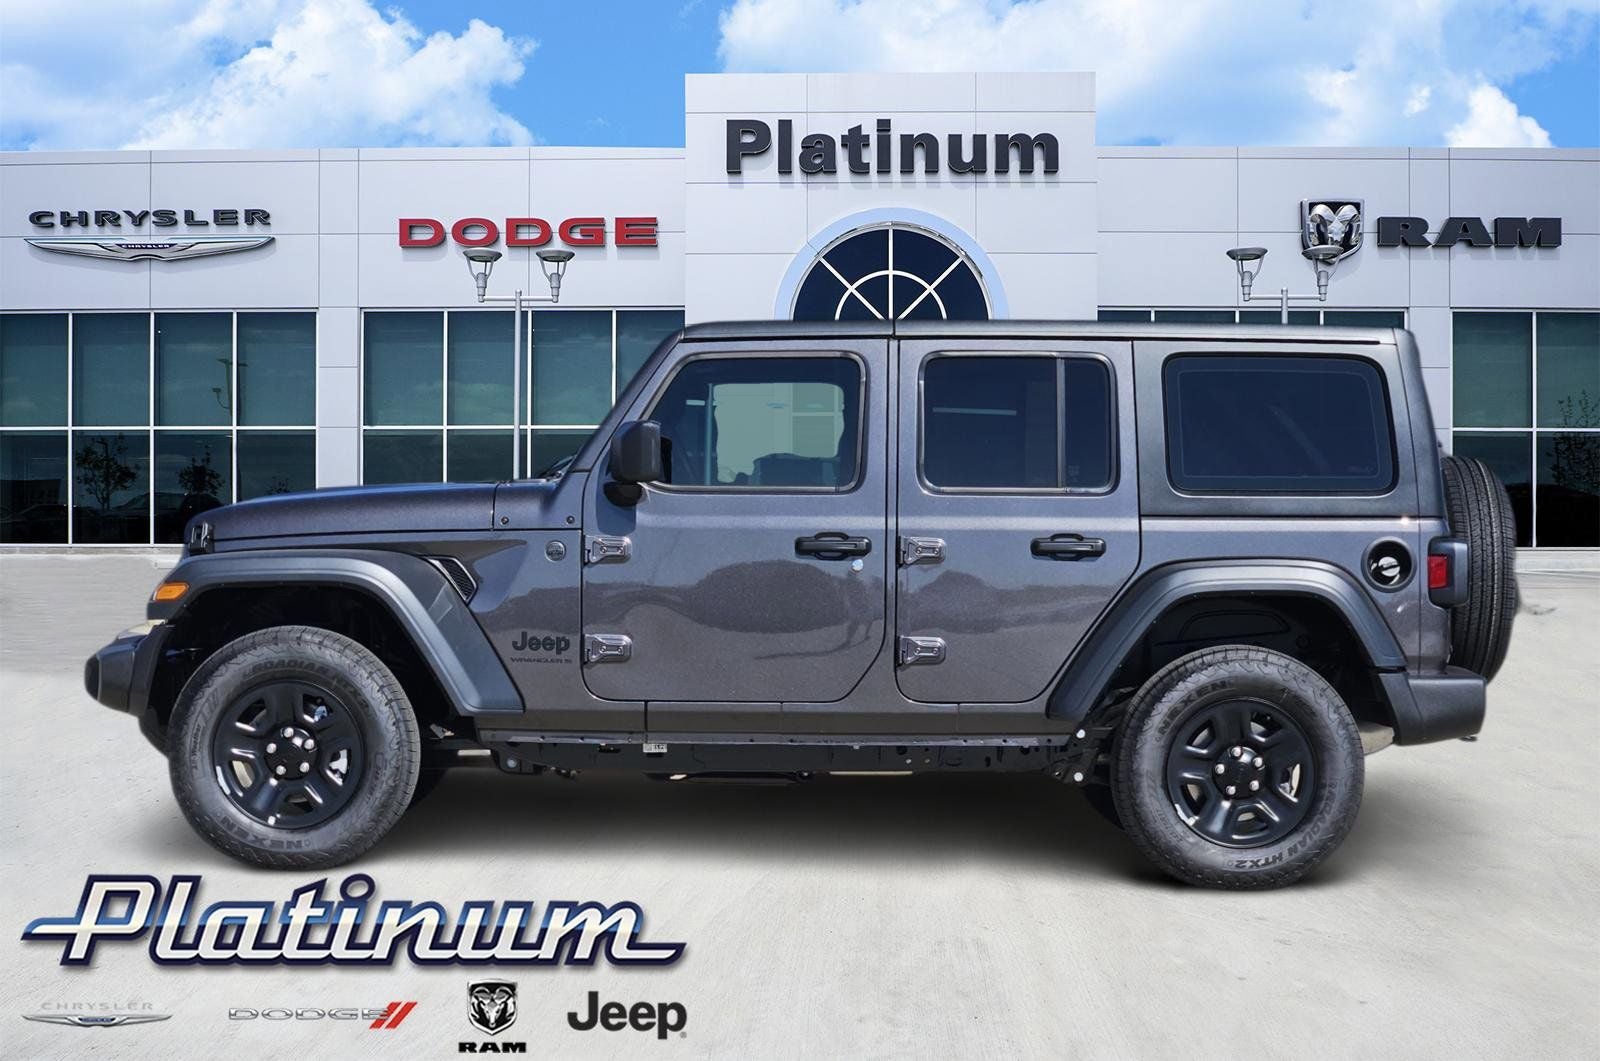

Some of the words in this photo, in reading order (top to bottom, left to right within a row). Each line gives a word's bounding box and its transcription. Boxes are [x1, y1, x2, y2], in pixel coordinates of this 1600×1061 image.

[726, 119, 1060, 175] Platinum
[28, 208, 271, 228] CHRYSLER
[398, 217, 659, 248] DODGE
[1377, 216, 1562, 248] RAM
[512, 631, 570, 655] Jeep
[1158, 681, 1227, 735] NEXEN
[220, 816, 303, 849] NEXEN
[1235, 852, 1283, 869] HTX2
